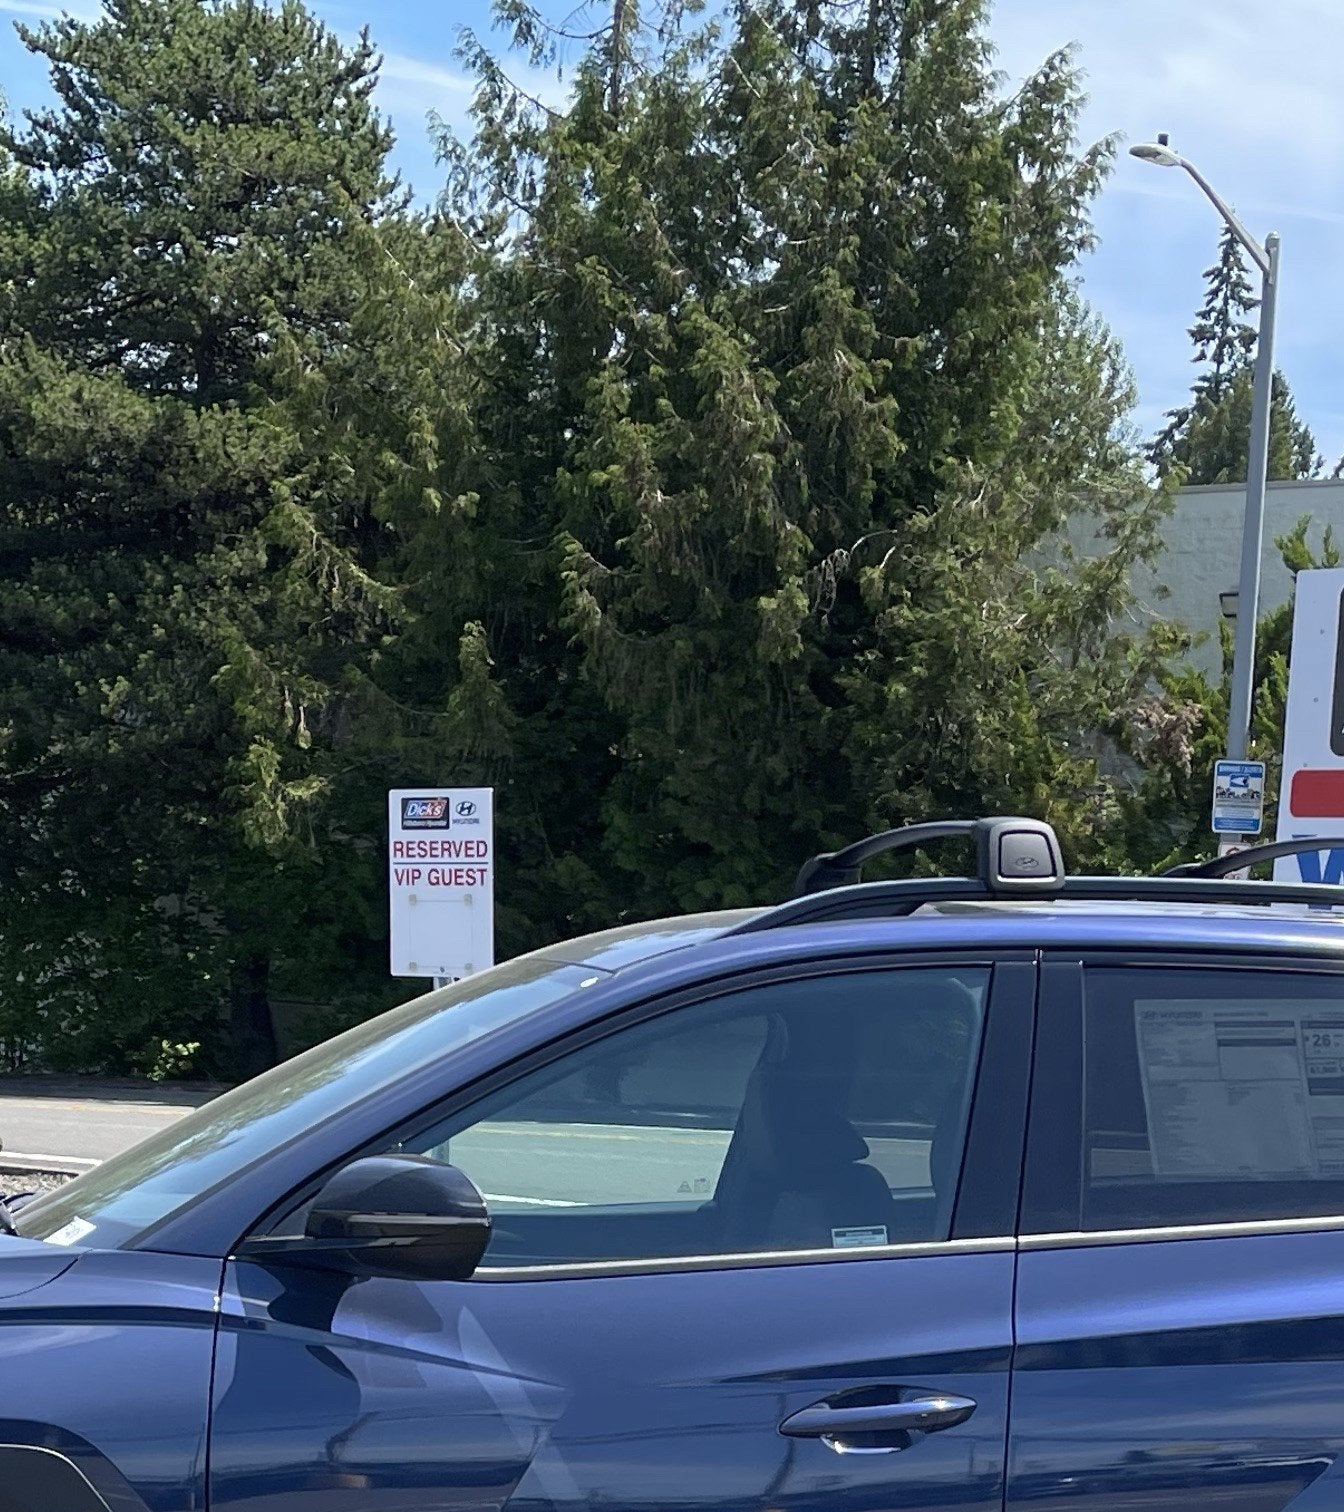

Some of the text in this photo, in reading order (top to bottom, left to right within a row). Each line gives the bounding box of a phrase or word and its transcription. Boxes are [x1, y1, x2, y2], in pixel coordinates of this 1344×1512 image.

[393, 840, 488, 858] RESERVED
[394, 868, 488, 886] VIP GUEST
